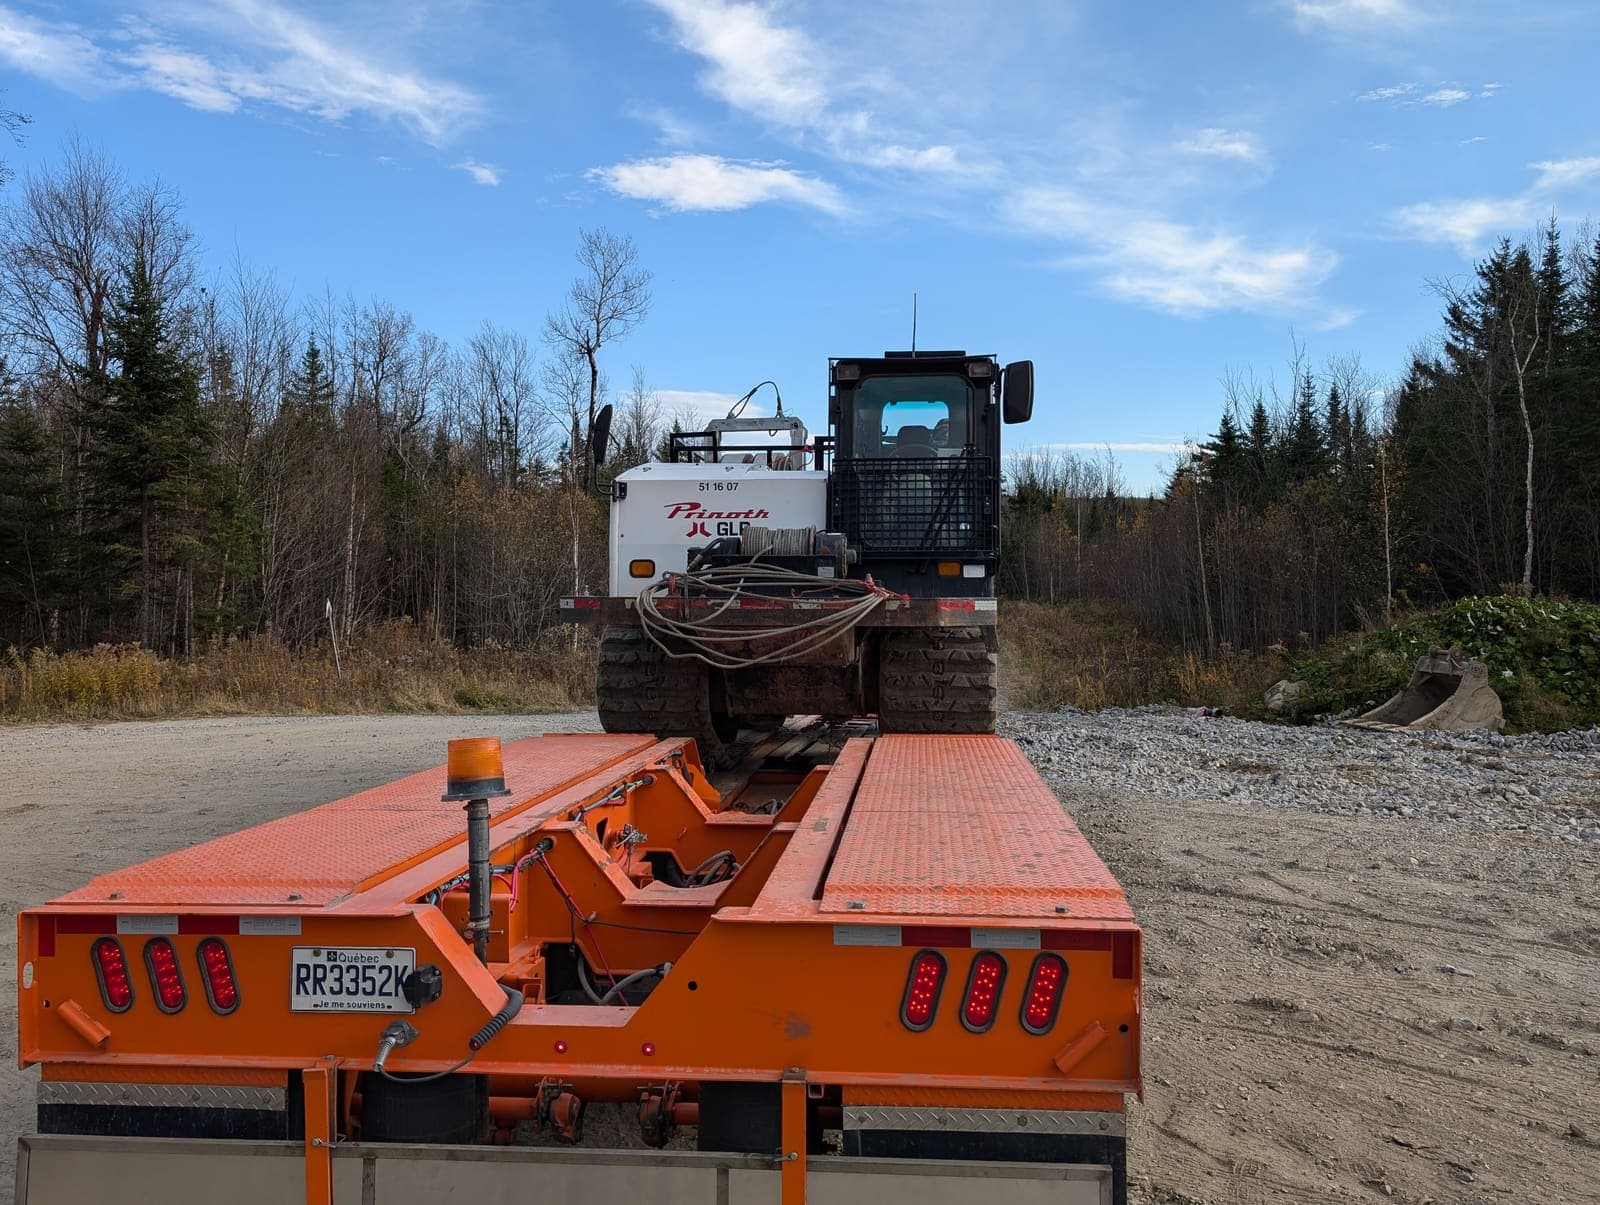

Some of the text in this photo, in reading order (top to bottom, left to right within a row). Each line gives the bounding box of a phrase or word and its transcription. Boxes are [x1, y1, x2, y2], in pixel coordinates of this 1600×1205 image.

[698, 482, 739, 492] 51 16 07
[664, 501, 770, 520] Prinoth
[338, 952, 380, 964] Québec
[295, 963, 409, 997] RR3352K
[320, 1001, 329, 1009] Je
[346, 1002, 386, 1010] souviens
